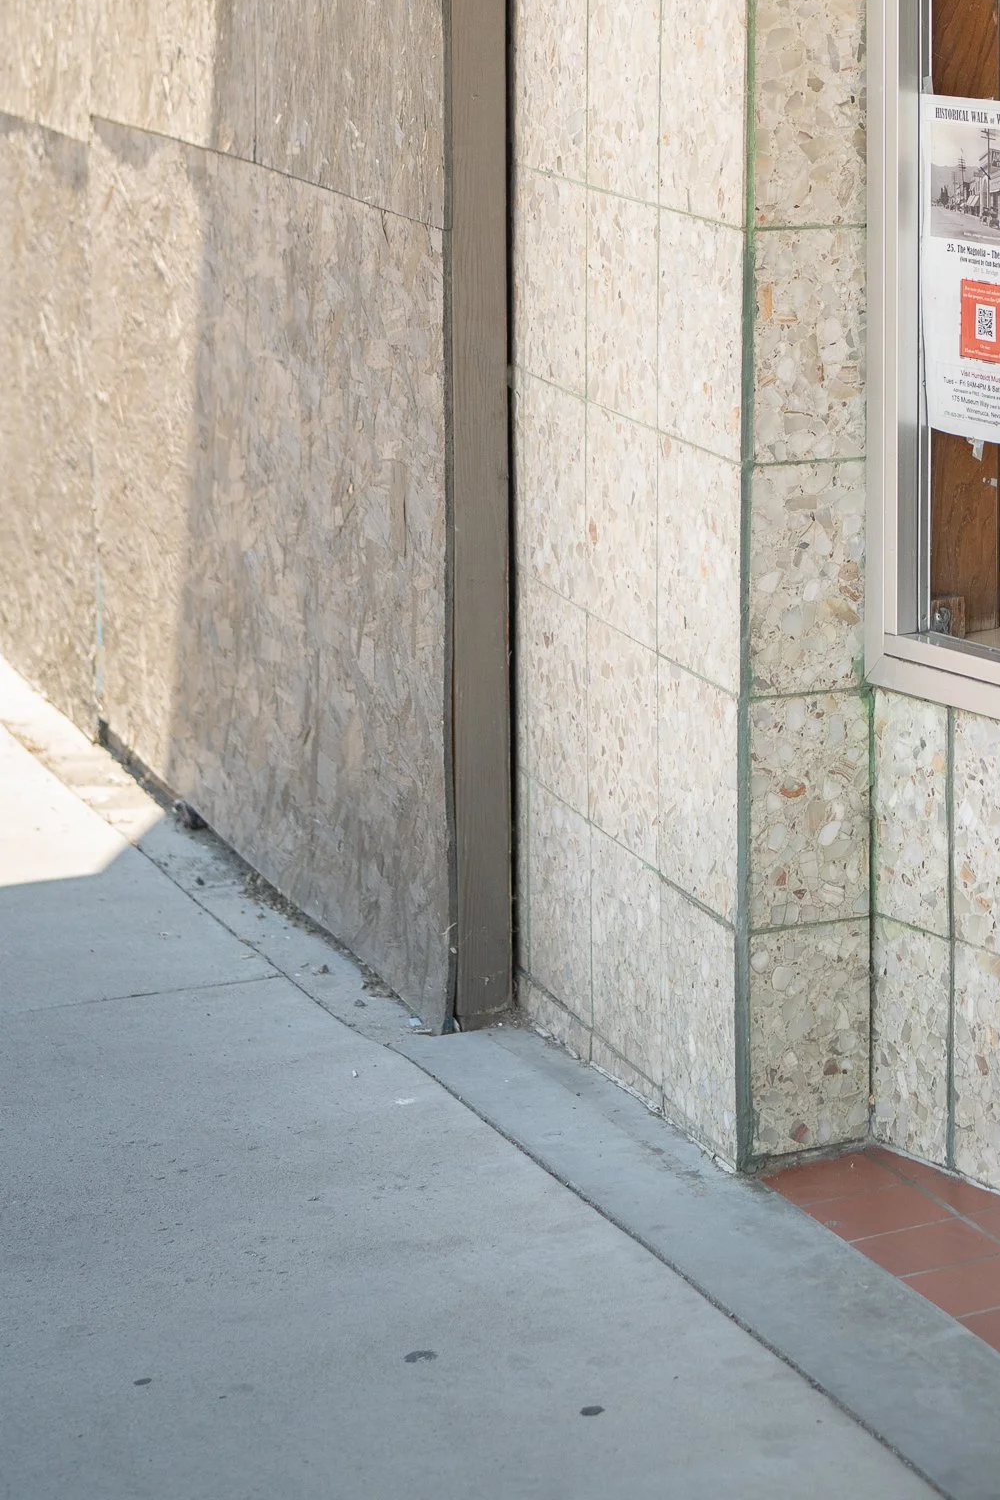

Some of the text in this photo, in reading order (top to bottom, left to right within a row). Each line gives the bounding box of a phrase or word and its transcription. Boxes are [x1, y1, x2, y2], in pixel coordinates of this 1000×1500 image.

[935, 107, 969, 122] HISTORICAL
[970, 110, 989, 124] WALK
[946, 243, 956, 253] 25.
[957, 244, 966, 254] The
[966, 245, 986, 257] Magnolia
[991, 249, 1000, 259] The
[960, 369, 970, 377] Visit
[971, 371, 990, 382] Humboldt
[960, 396, 979, 406] Museum
